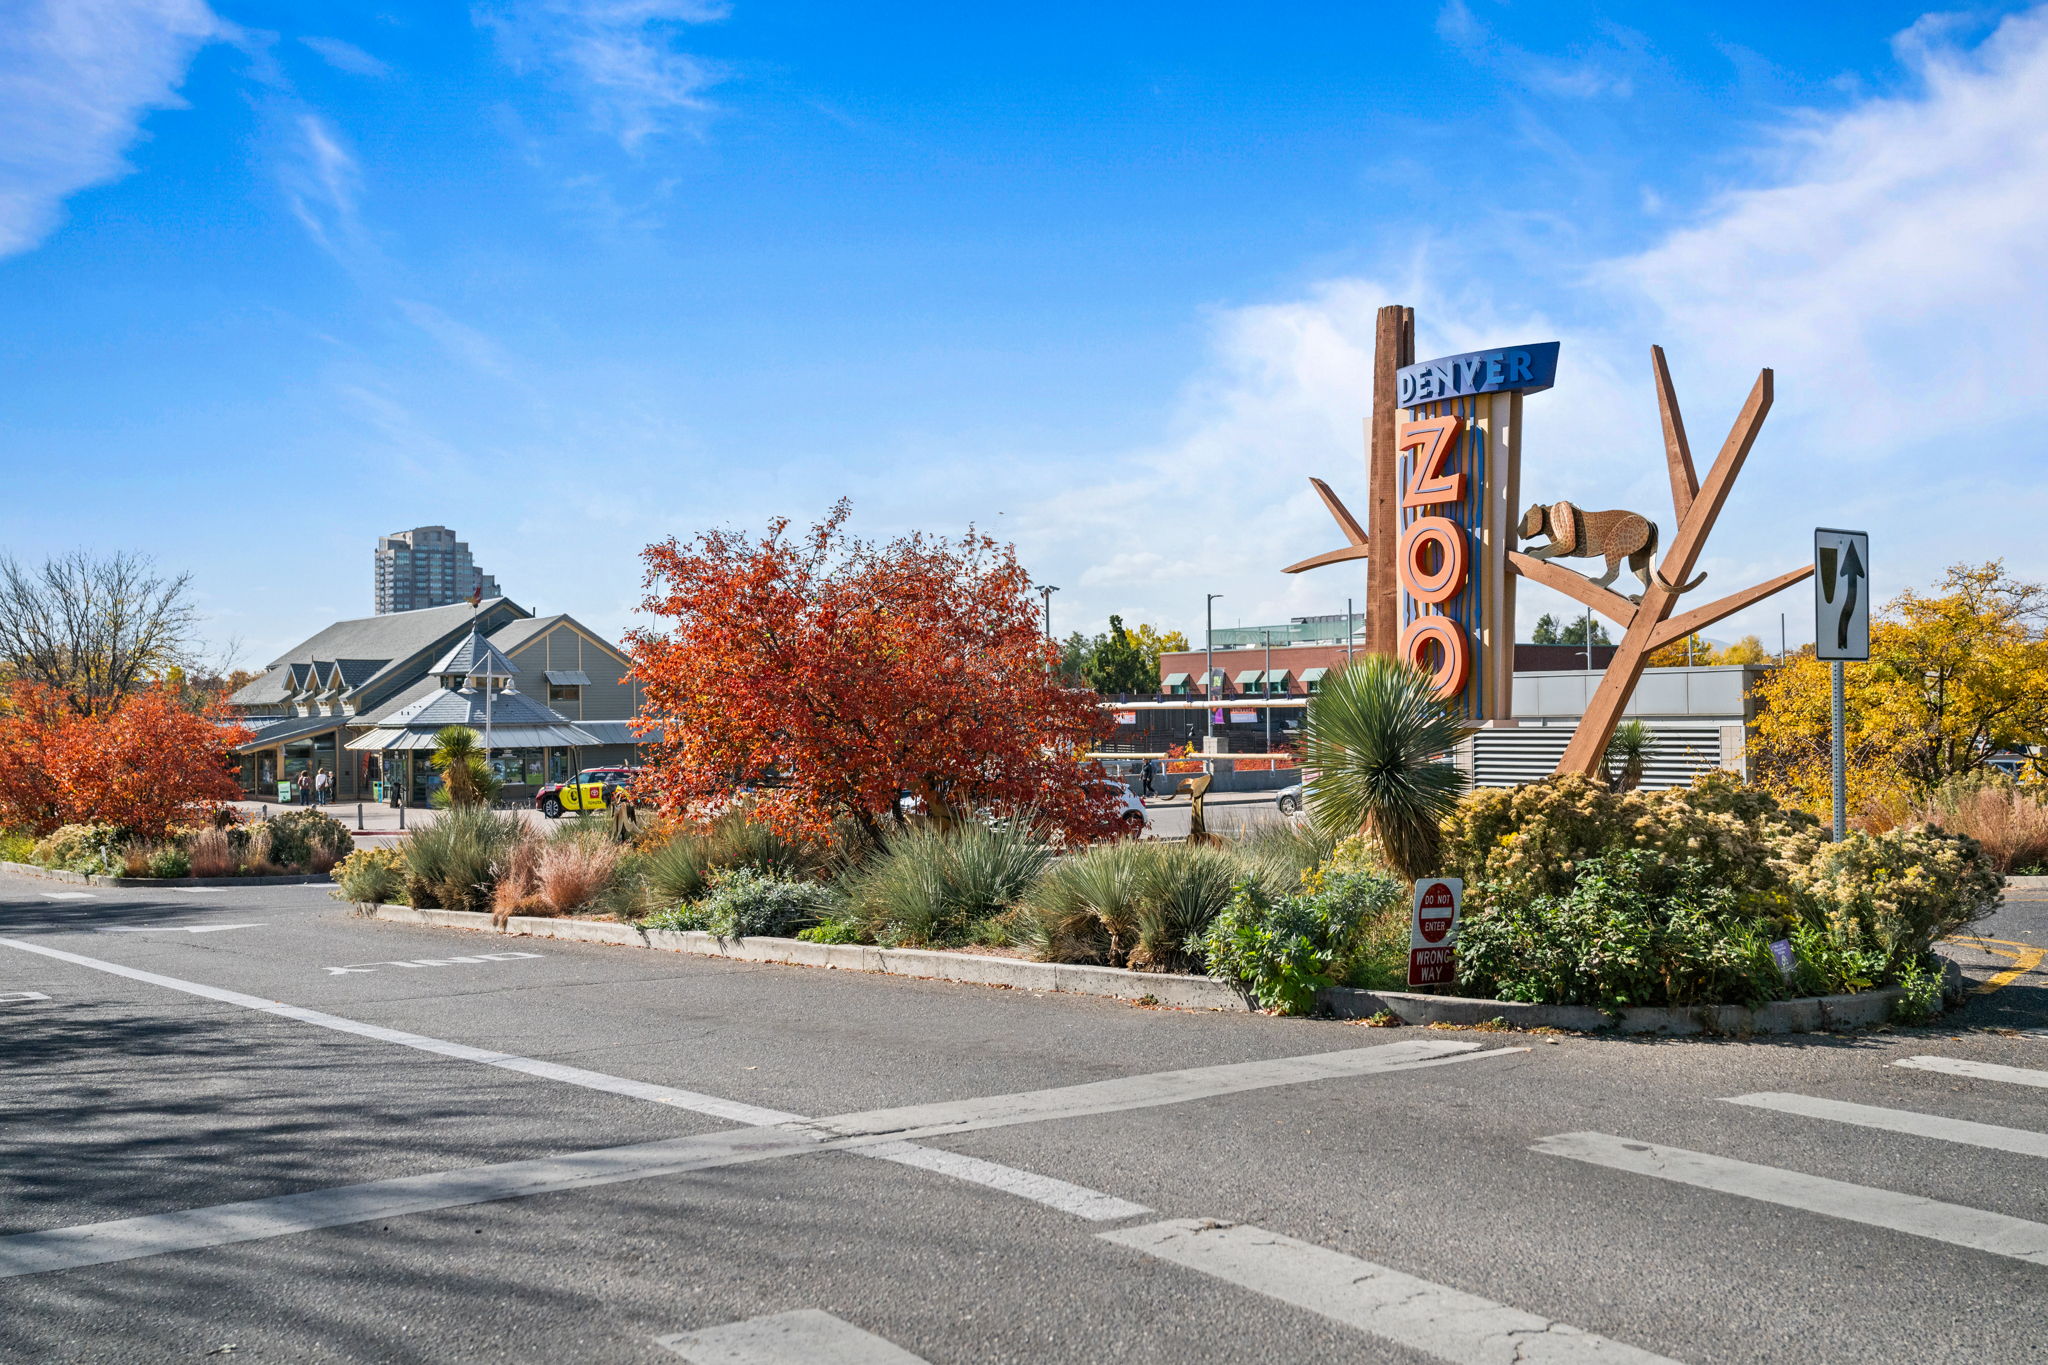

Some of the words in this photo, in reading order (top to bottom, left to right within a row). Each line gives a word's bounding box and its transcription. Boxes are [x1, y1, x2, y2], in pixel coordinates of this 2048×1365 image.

[1401, 351, 1534, 401] DENVER
[1399, 416, 1469, 698] ZOO
[1425, 895, 1434, 905] DO
[1437, 894, 1451, 904] NOT
[1424, 921, 1446, 932] ENTER
[1421, 966, 1442, 982] WAY
